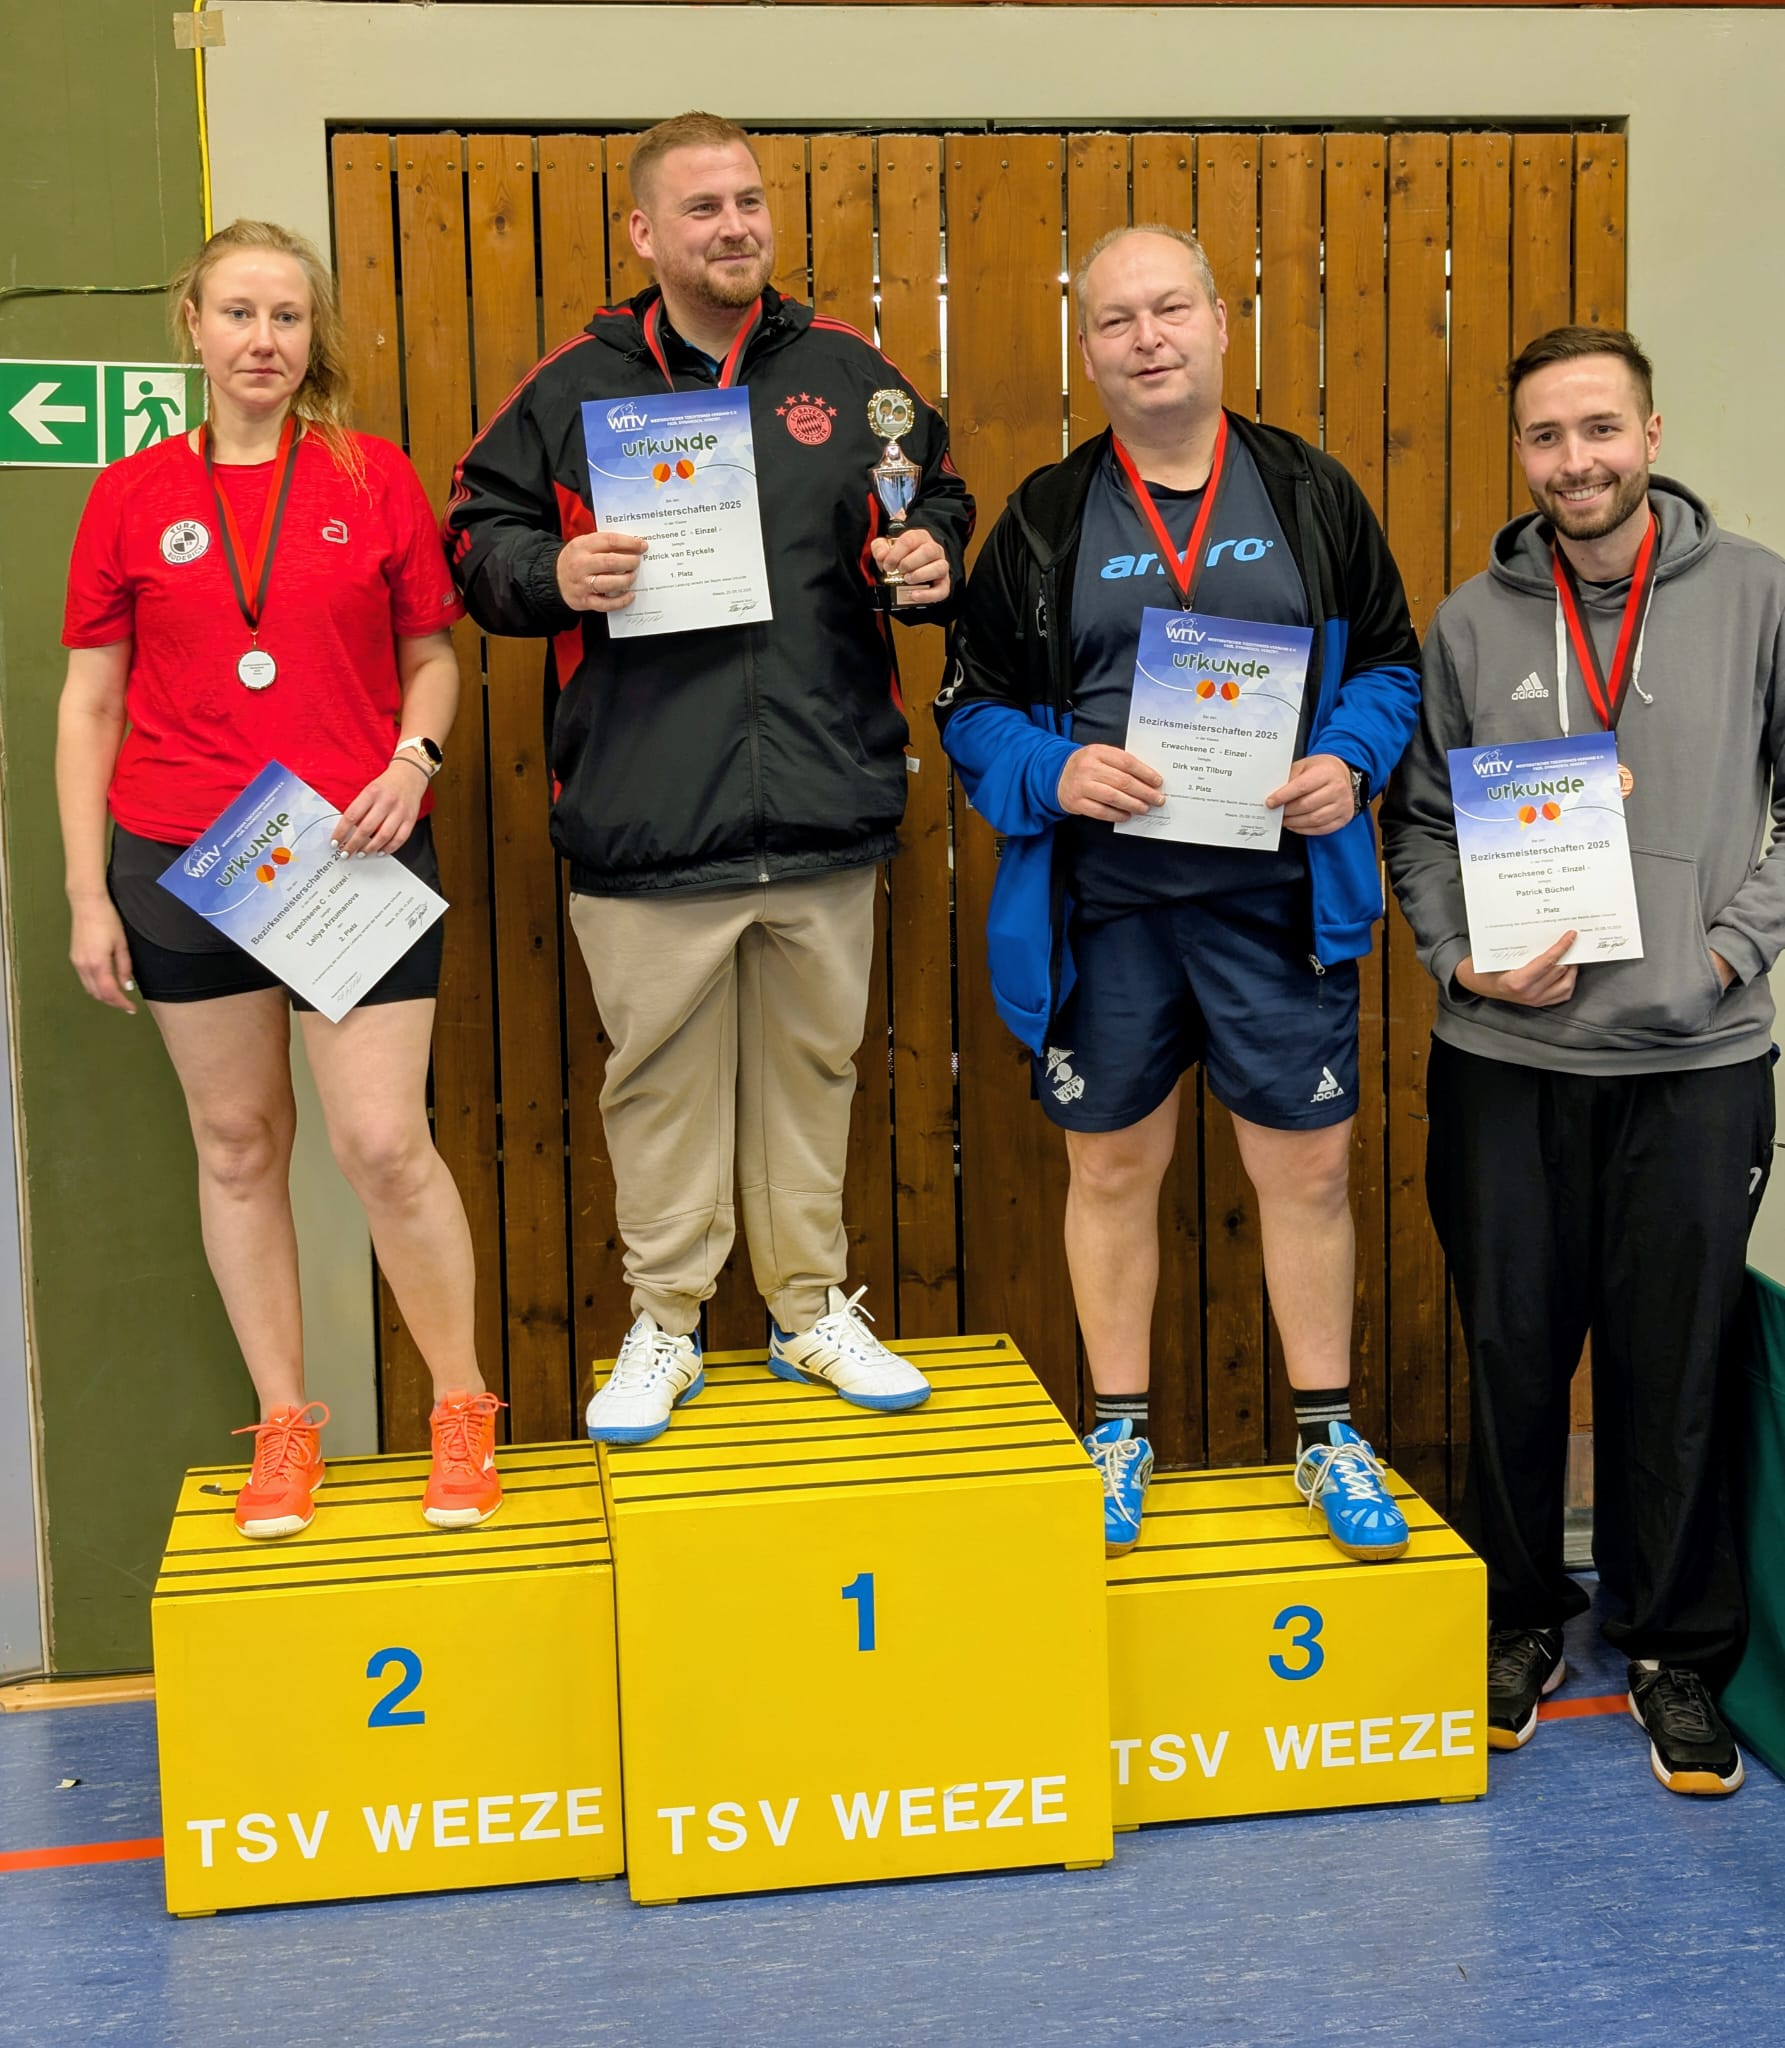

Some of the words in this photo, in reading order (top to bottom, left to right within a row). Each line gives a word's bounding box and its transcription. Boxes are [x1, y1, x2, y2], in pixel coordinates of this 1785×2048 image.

[607, 414, 648, 430] WTTV
[605, 504, 717, 524] Bezirksmeisterschaften
[719, 500, 742, 511] 2025
[170, 522, 196, 534] TURA
[634, 531, 678, 541] rwachsene
[680, 529, 686, 537] C
[695, 526, 718, 535] Einzel
[643, 551, 669, 562] Patrick
[686, 547, 715, 558] Eyckels
[677, 570, 693, 578] Platz
[1166, 627, 1207, 642] WTTV
[1511, 689, 1549, 700] adidas
[1139, 715, 1252, 737] Bezirksmeisterschaften
[1254, 729, 1279, 740] 2025
[1161, 741, 1208, 754] Erwachsene
[1209, 746, 1215, 754] C
[1224, 749, 1247, 758] Einzel
[1172, 762, 1188, 770] Dirk
[1206, 766, 1233, 776] Tilburg
[1473, 760, 1513, 776] WTTV
[1195, 784, 1212, 793] Platz
[1470, 842, 1585, 862] Bezirksmeisterschaften
[1587, 840, 1610, 850] 2025
[188, 845, 220, 878] WTTV
[1498, 869, 1545, 880] Erwachsene
[1562, 865, 1585, 873] Einzel
[1516, 888, 1543, 897] Patrick
[251, 861, 334, 946] Bezirksmeisterschaften
[286, 903, 322, 941] Erwachsene
[329, 875, 350, 895] Einzel
[324, 892, 360, 930] Arzumanova
[343, 922, 359, 938] Platz
[1310, 1087, 1344, 1103] JOOLA
[841, 1572, 876, 1651] 1
[1268, 1604, 1325, 1681] 3
[366, 1647, 426, 1728] 2
[1110, 1730, 1230, 1785] TSV
[1264, 1709, 1475, 1771] WEEZE
[657, 1797, 800, 1855] TSV
[831, 1774, 1068, 1840] WEEZE
[186, 1810, 330, 1868] TSV
[362, 1786, 604, 1854] WEEZE
